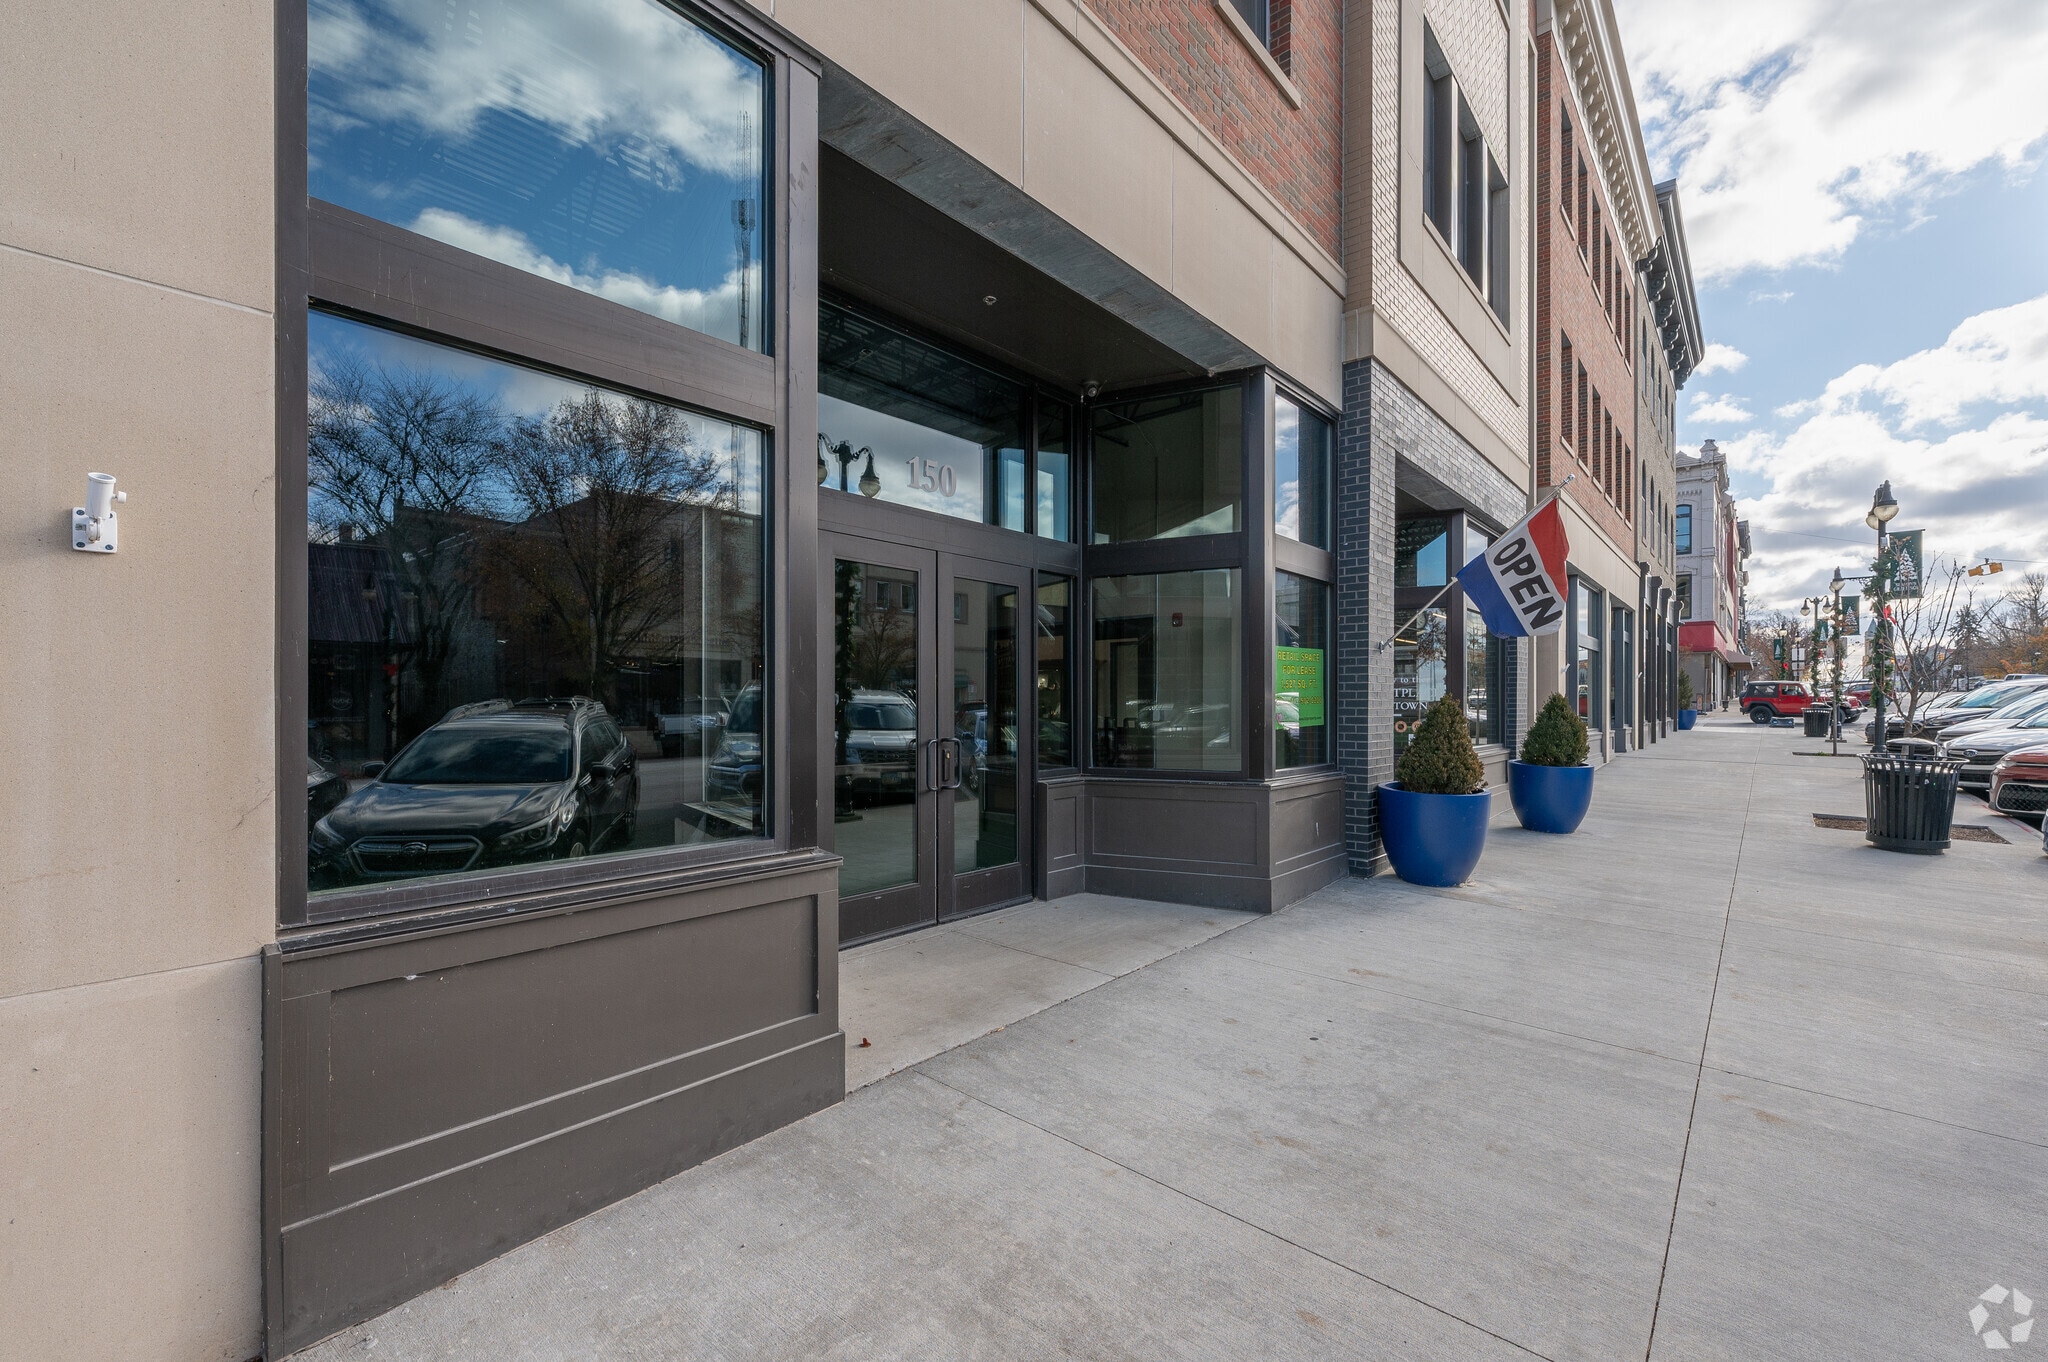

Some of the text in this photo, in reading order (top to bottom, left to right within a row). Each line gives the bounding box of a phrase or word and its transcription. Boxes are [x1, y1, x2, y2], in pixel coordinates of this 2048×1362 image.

[906, 456, 957, 497] 150
[1493, 537, 1563, 630] OPEN
[1277, 651, 1320, 662] RETAIL SPACE
[1282, 665, 1316, 675] FOR LEASE
